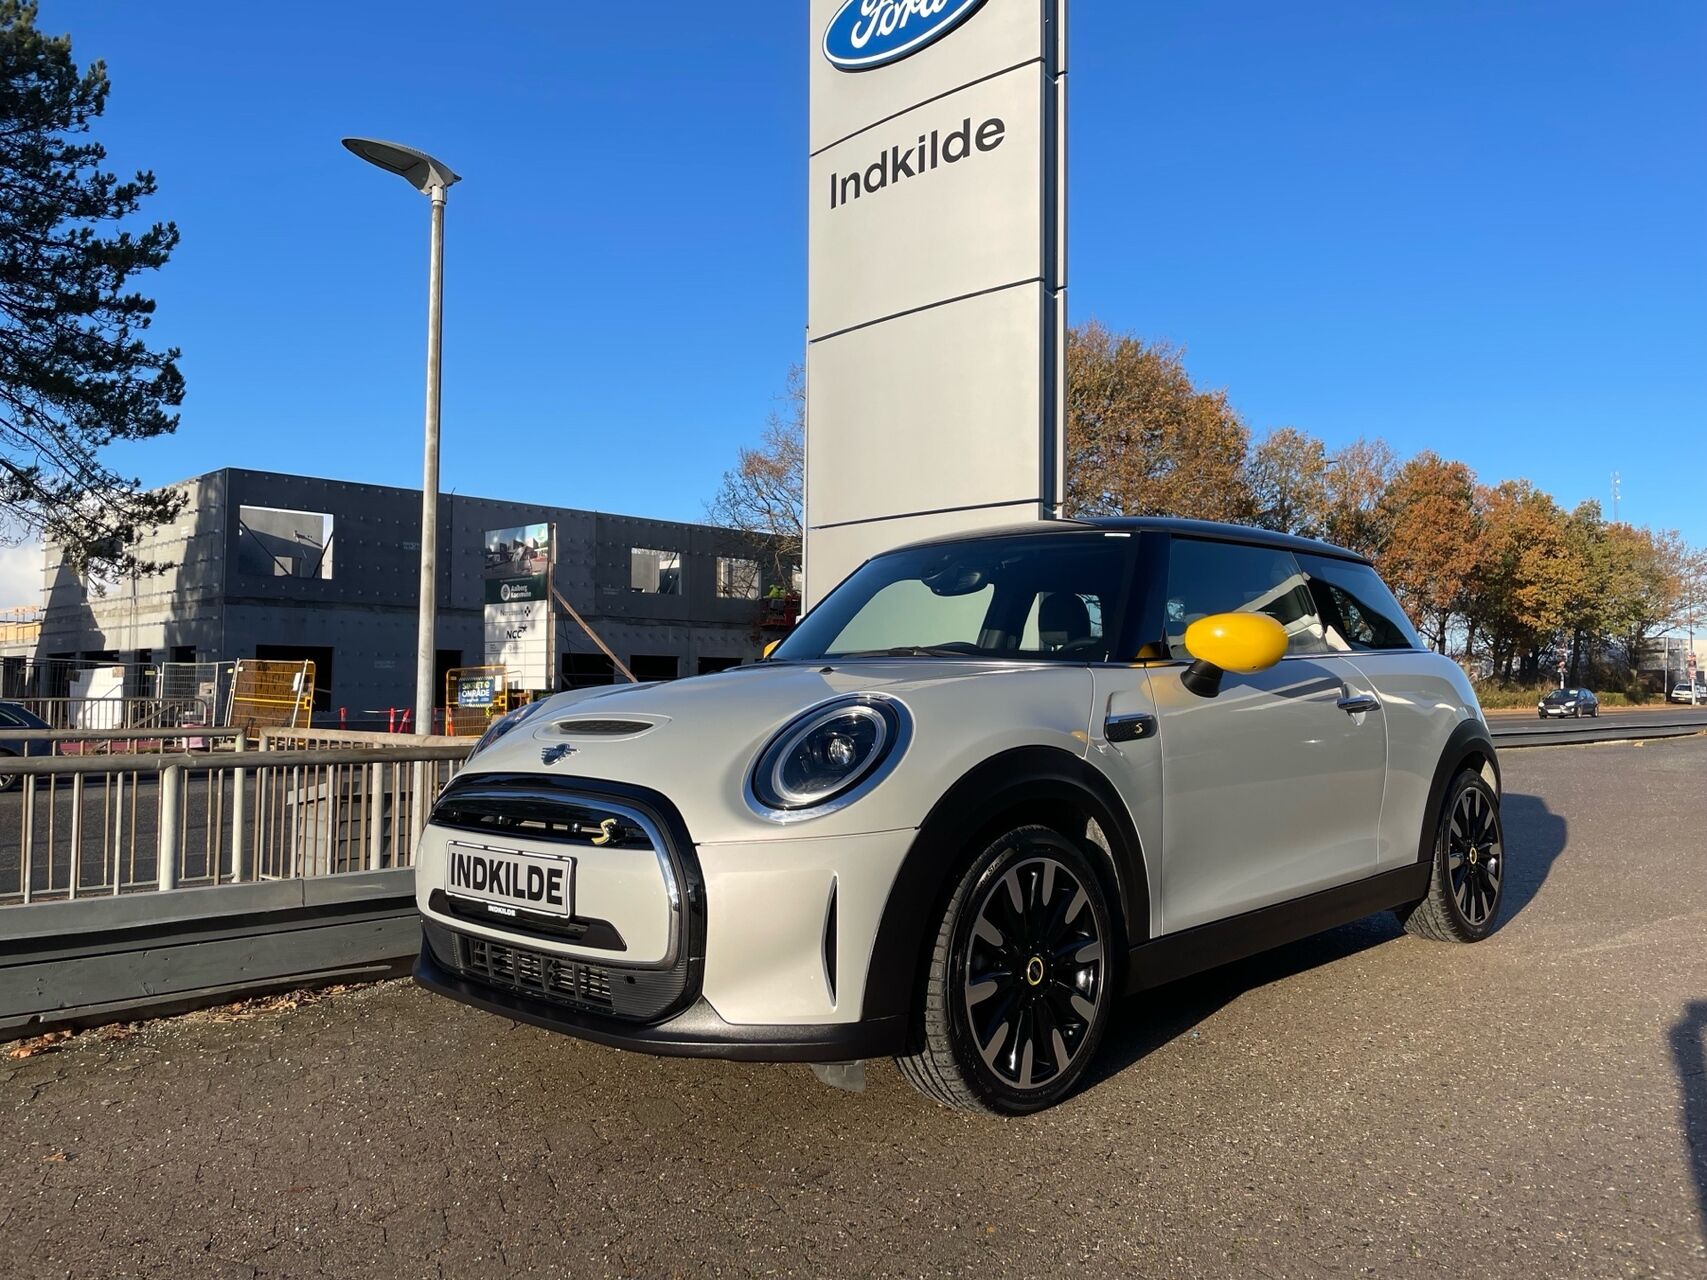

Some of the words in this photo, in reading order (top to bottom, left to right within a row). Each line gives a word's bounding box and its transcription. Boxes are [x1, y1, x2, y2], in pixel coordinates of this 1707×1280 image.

[829, 116, 1006, 210] Indkilde
[506, 629, 522, 639] NCC
[450, 852, 563, 906] INDKILDE
